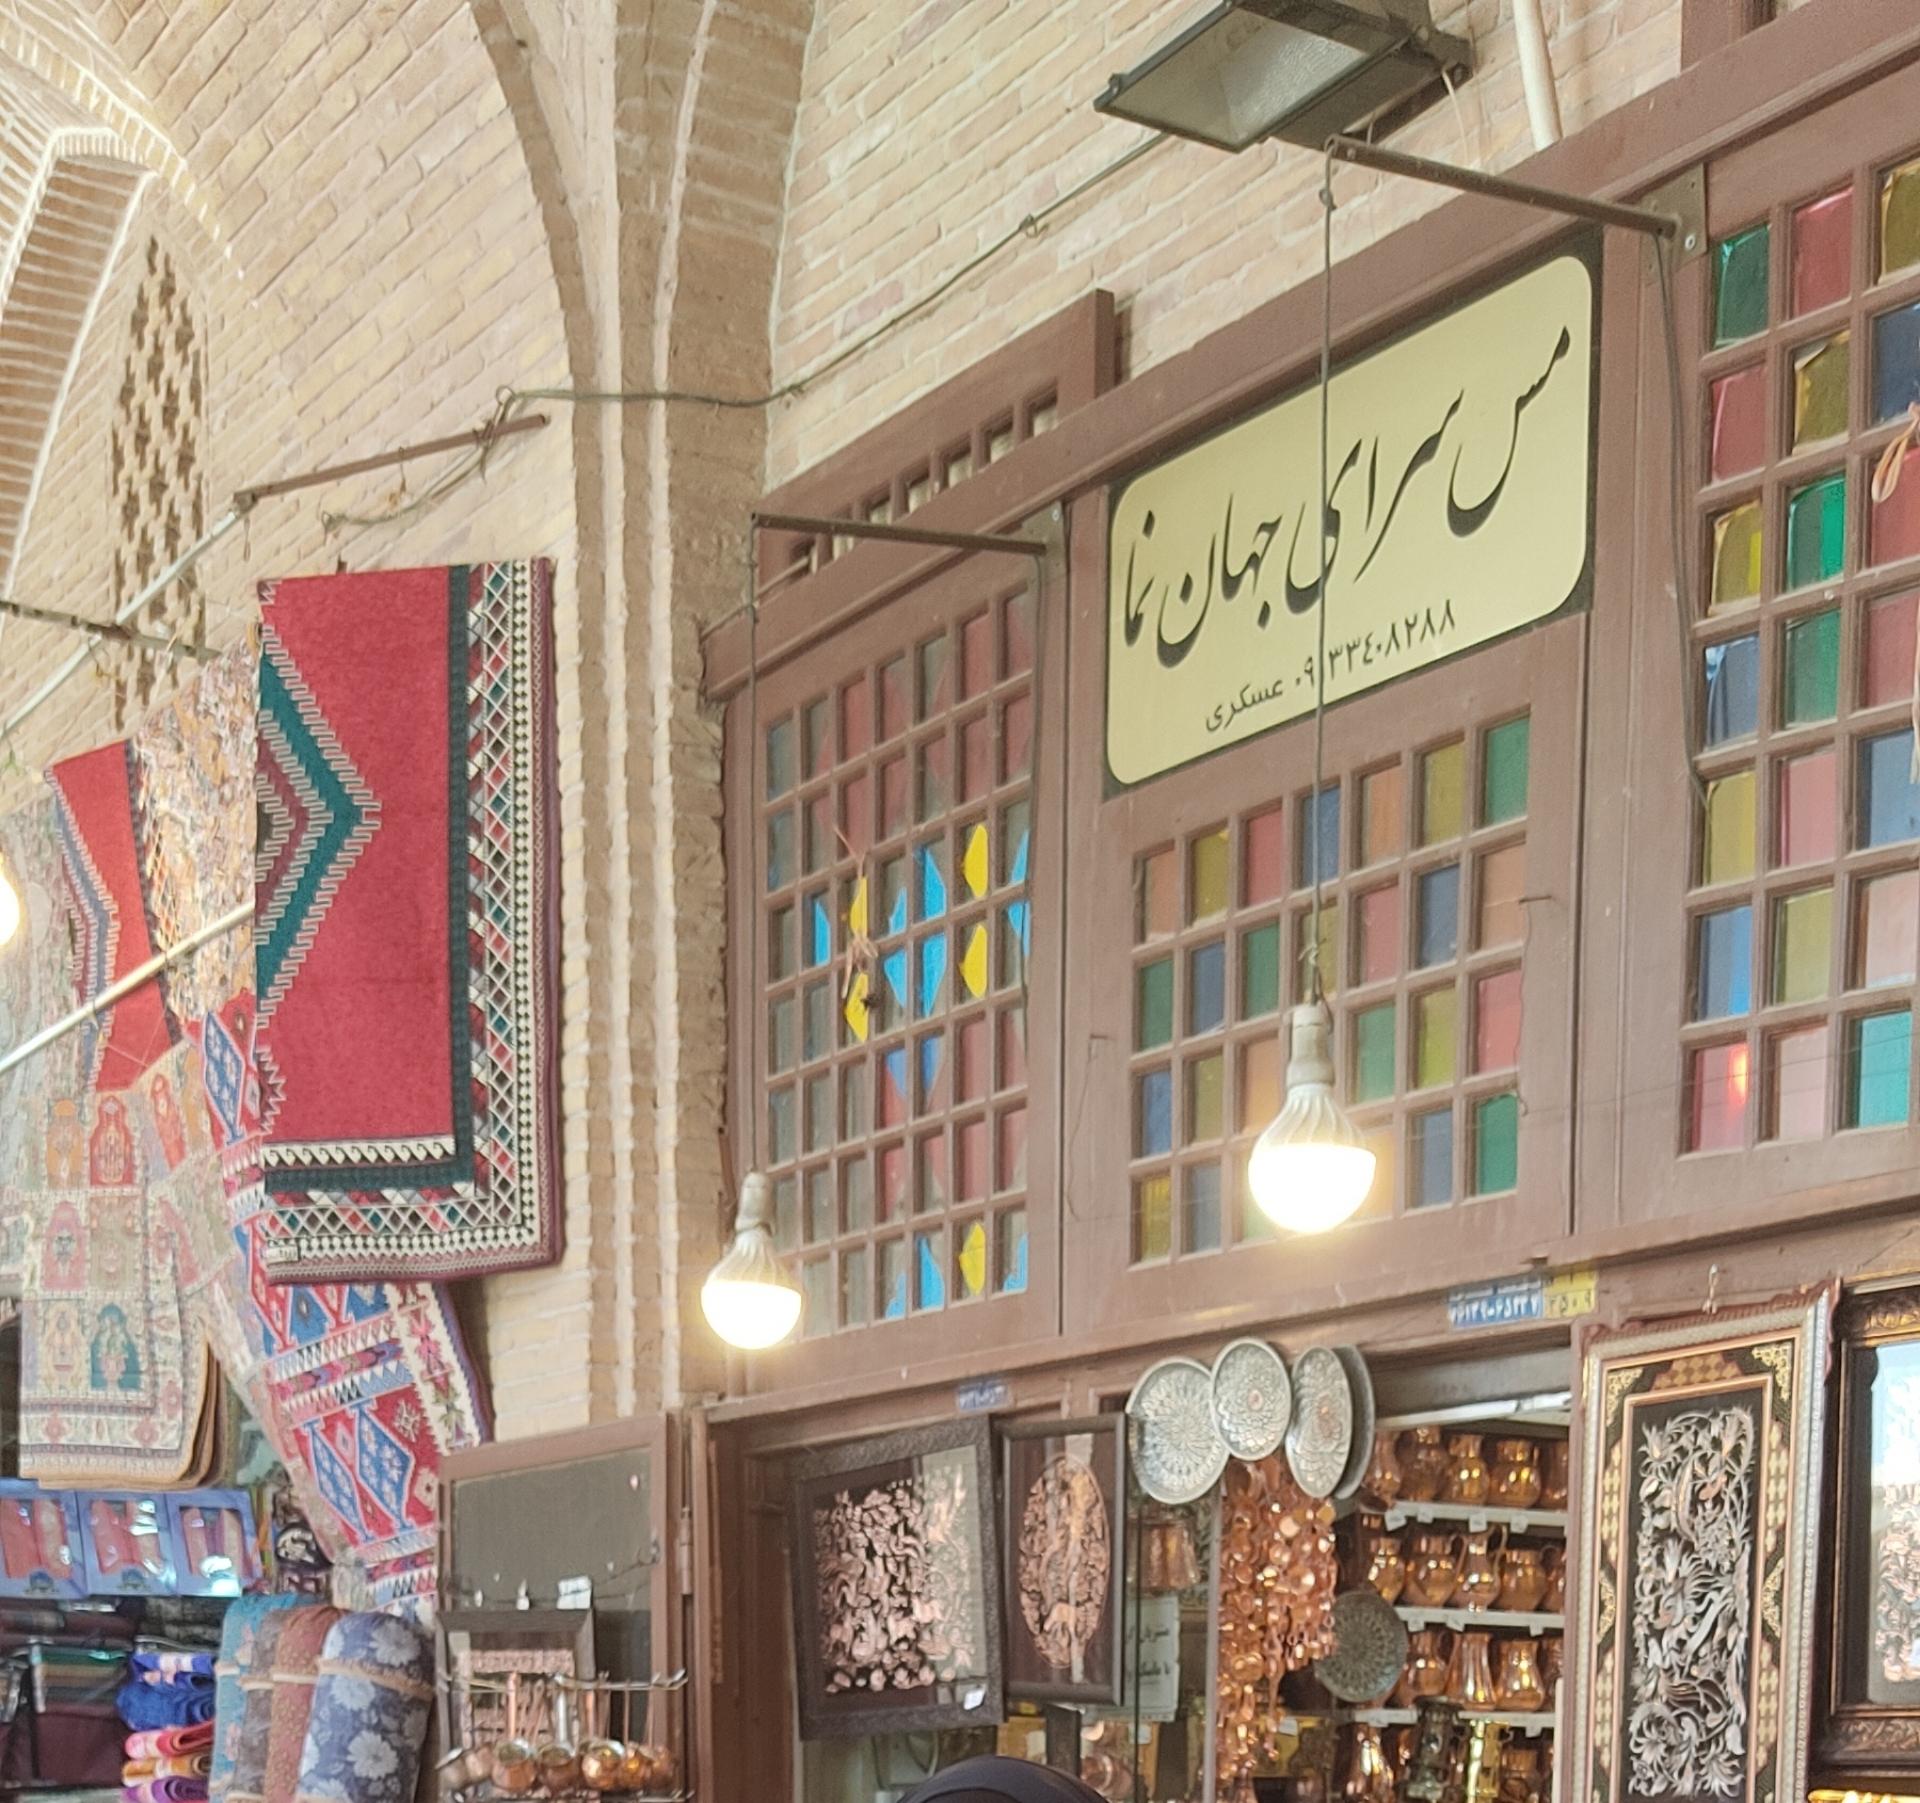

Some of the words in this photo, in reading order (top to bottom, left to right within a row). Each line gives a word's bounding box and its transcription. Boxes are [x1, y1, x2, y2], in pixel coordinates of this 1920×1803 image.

[1284, 388, 1464, 615] سرای
[1446, 325, 1571, 538] مس
[1124, 509, 1155, 647] نما
[1157, 493, 1282, 668] جهان
[1206, 679, 1284, 733] عسکری
